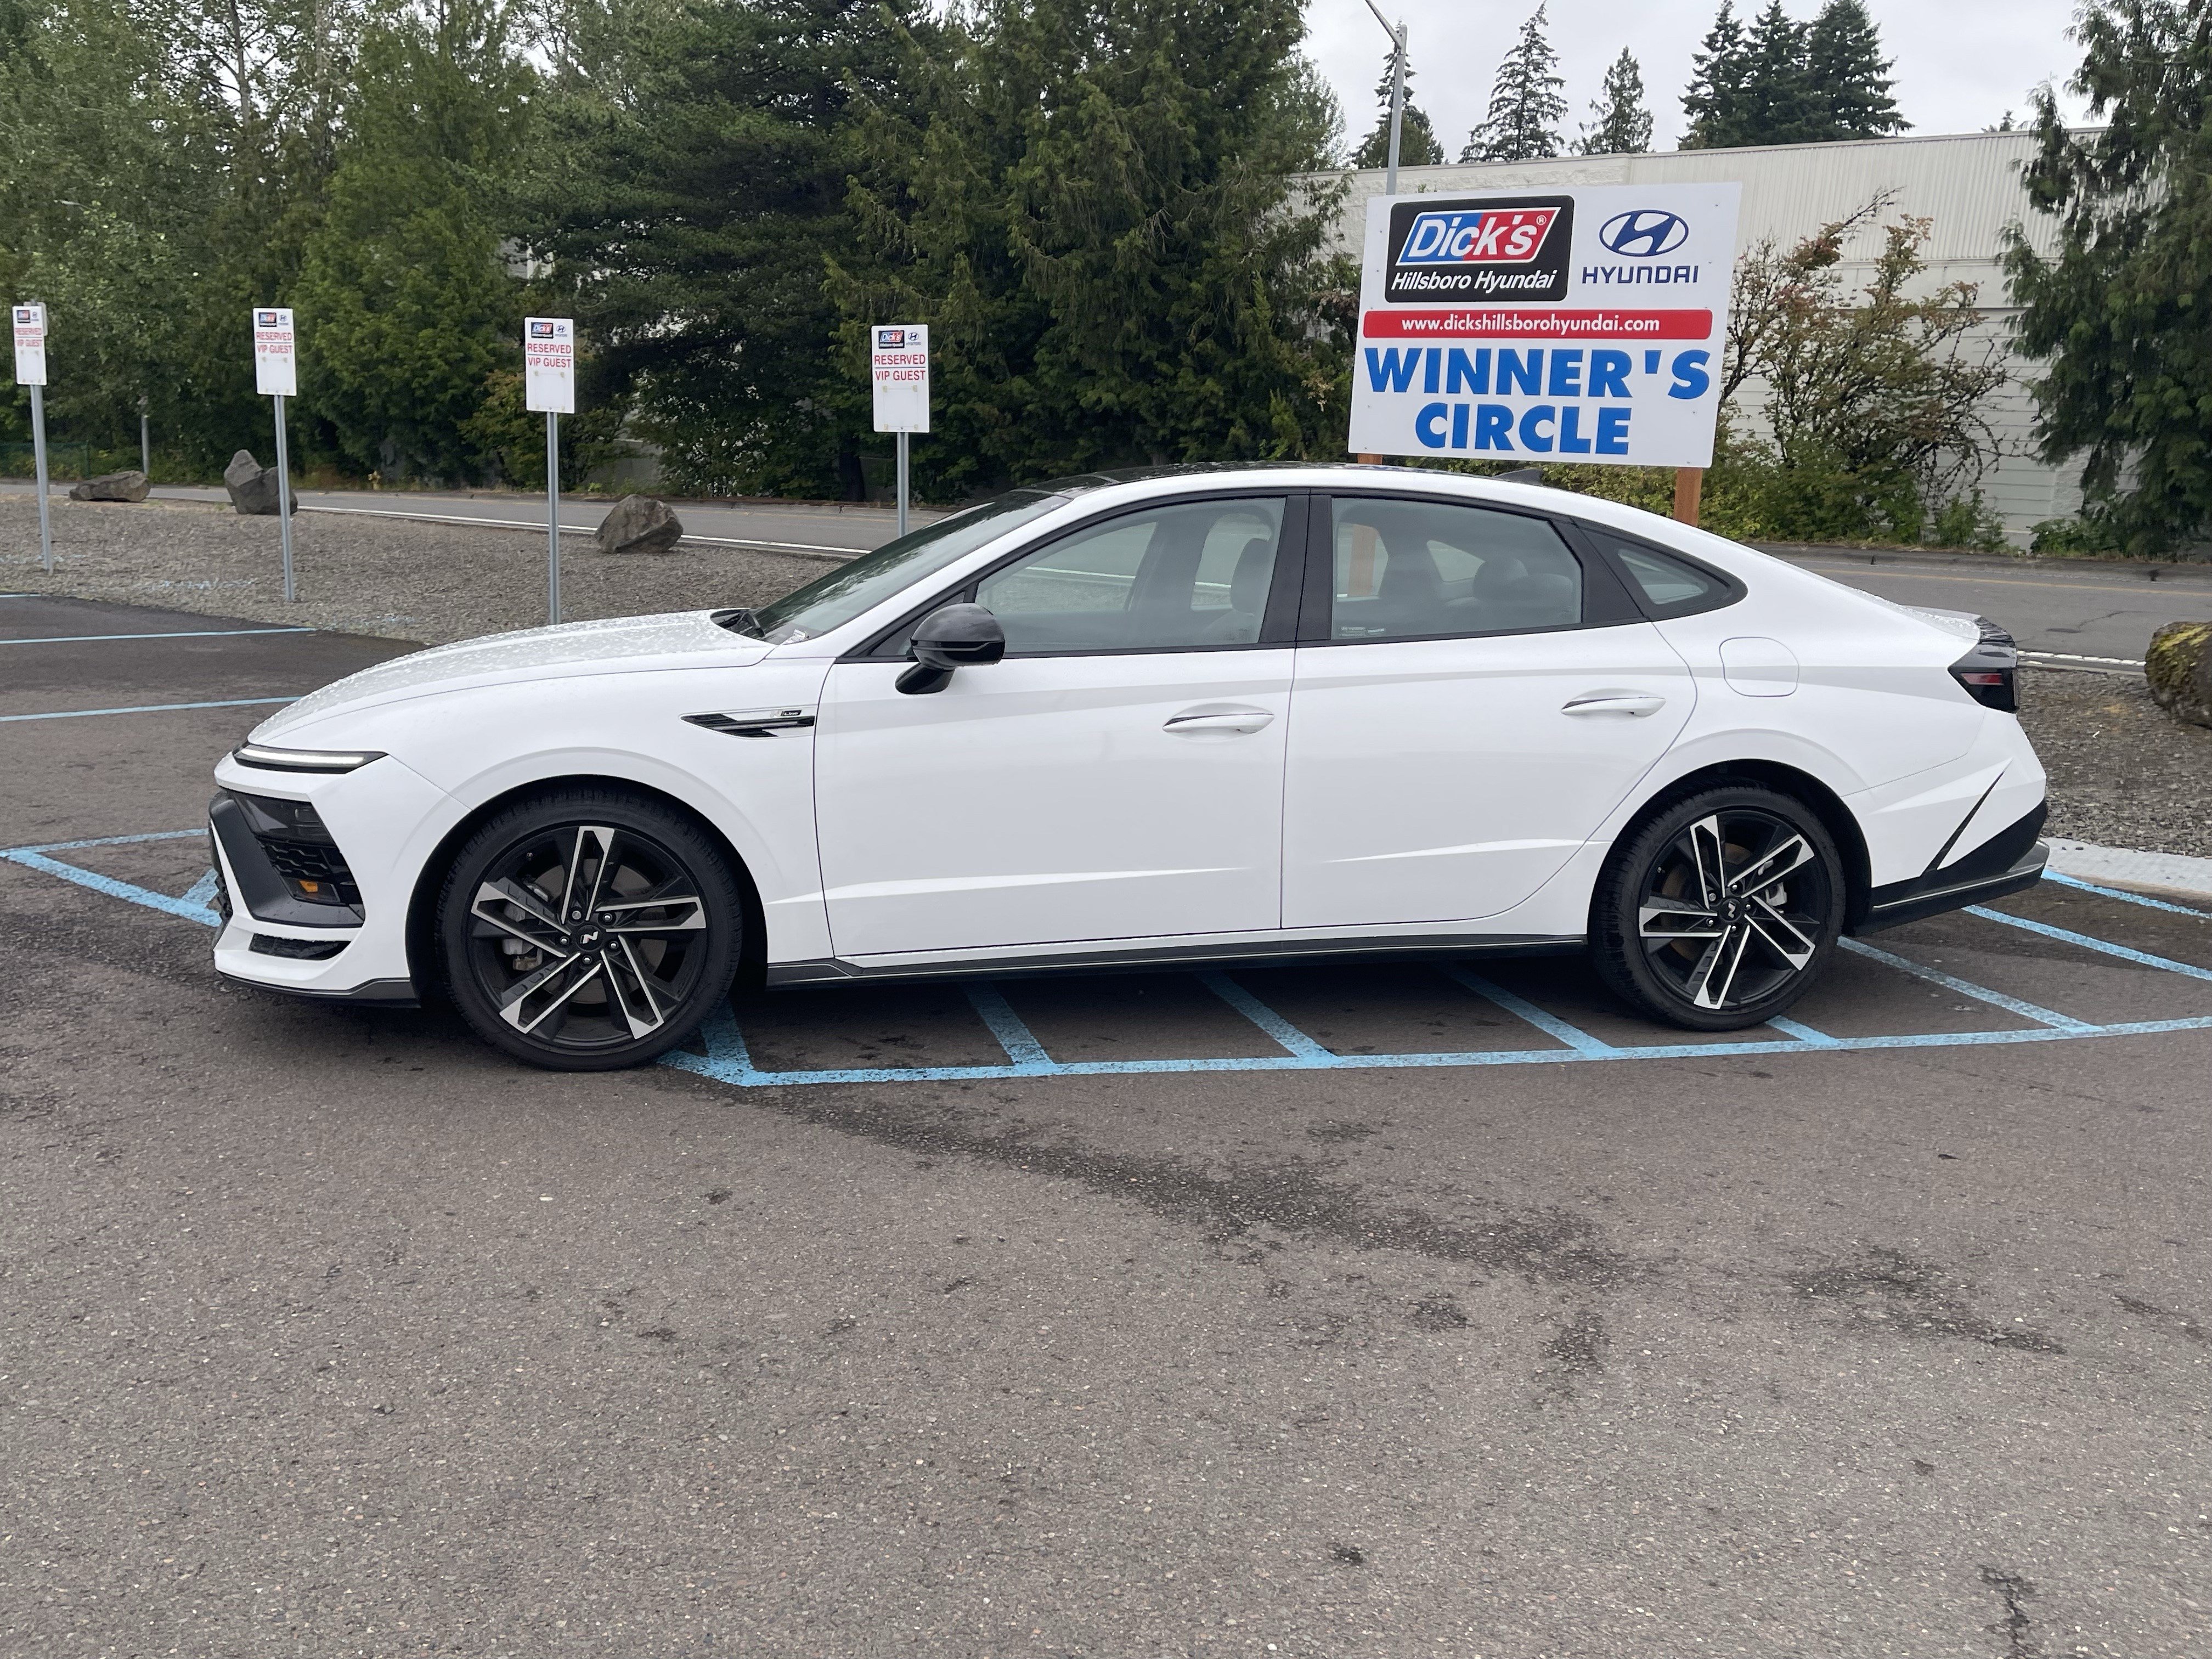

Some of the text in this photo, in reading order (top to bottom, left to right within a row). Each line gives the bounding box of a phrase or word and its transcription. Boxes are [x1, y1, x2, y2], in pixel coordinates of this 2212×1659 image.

[1582, 266, 1699, 284] HYUNDAI
[1390, 269, 1558, 294] Hillsboro Hyundai
[1401, 313, 1660, 336] www.dickshillsborohyundai.com
[256, 331, 292, 341] RESERVED
[257, 345, 292, 354] VIP GUEST
[527, 343, 572, 354] RESERVED
[528, 357, 572, 368] VIP GUEST
[874, 354, 926, 365] RESERVED
[875, 370, 926, 381] VIP GUEST
[1364, 347, 1711, 400] WINNER'S
[1414, 402, 1633, 455] CIRCLE
